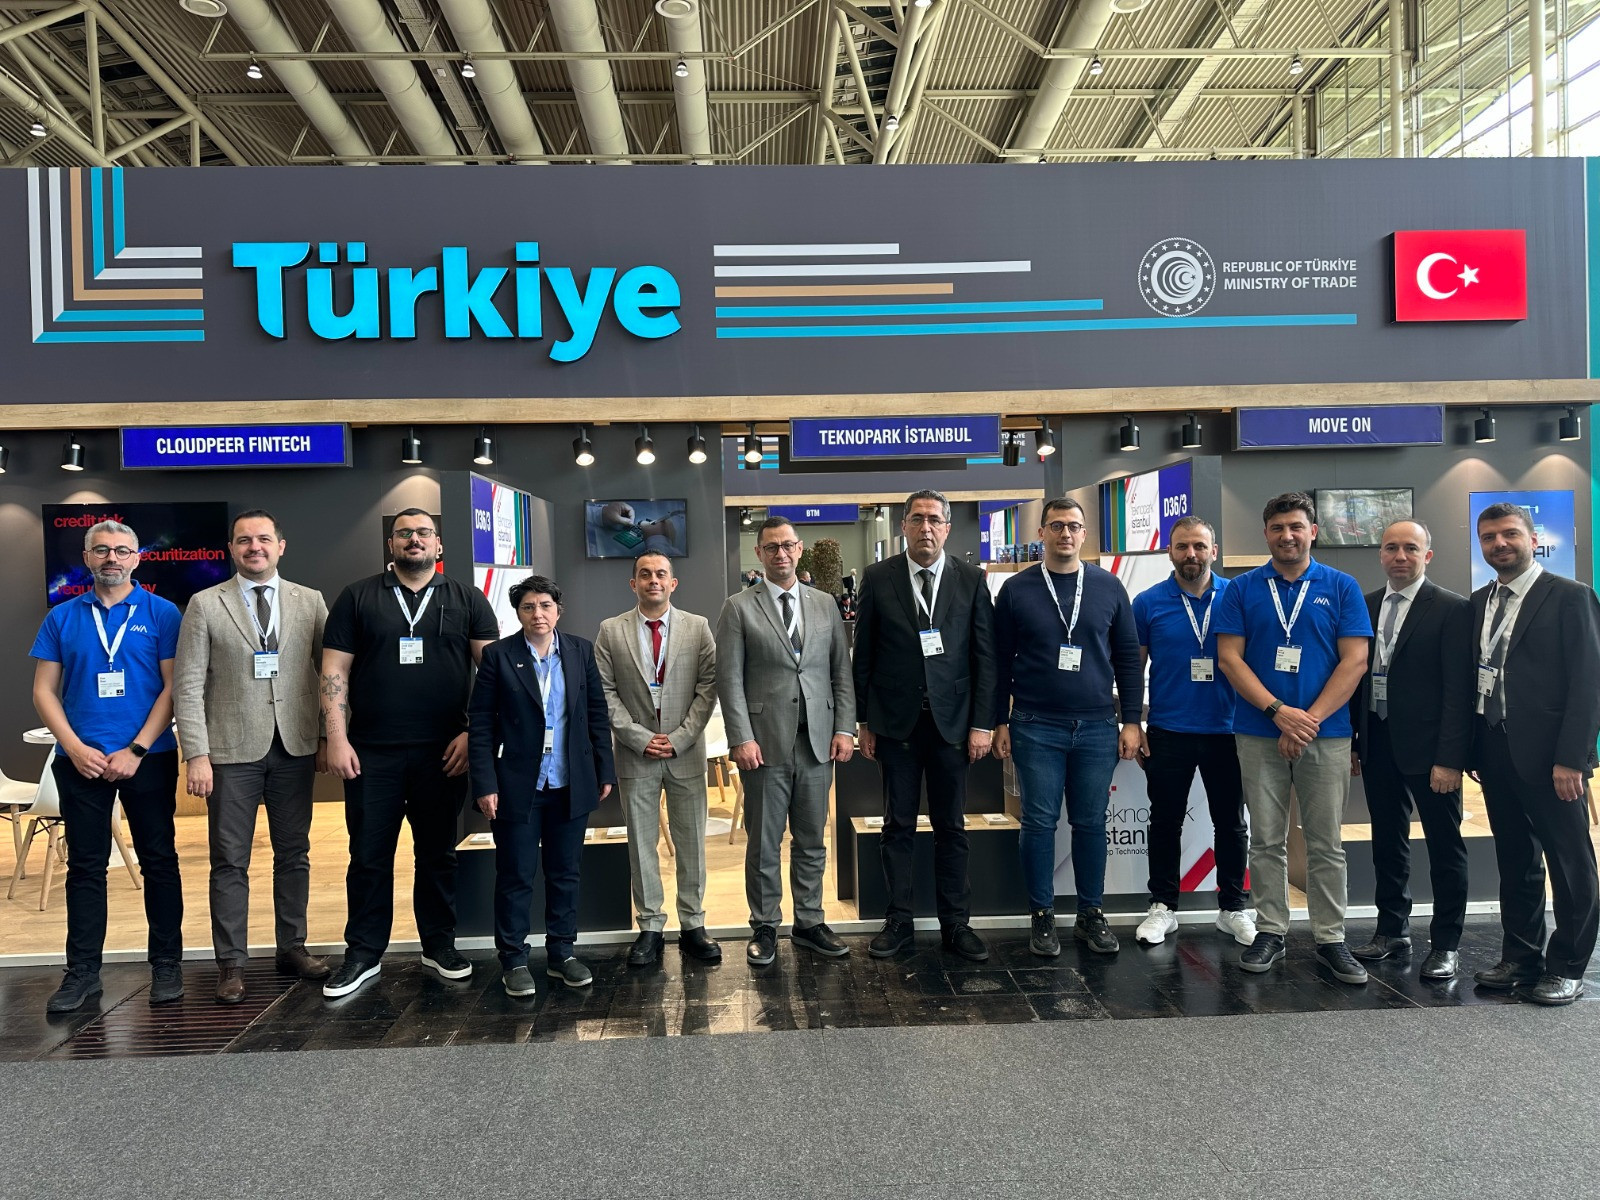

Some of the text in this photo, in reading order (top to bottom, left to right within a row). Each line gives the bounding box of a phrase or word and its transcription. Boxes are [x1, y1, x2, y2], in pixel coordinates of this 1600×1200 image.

[1222, 258, 1357, 273] REPUBLIC OF TÜRKİYE
[1224, 276, 1357, 290] MINISTRY OF TRADE
[232, 241, 682, 363] Türkiye
[1309, 417, 1371, 433] MOVE ON
[819, 425, 972, 445] TEKNOPARK İSTANBUL
[156, 436, 311, 454] CLOUDPEER FINTECH
[1163, 493, 1187, 517] D36/3
[806, 509, 820, 517] BTM
[54, 514, 96, 528] credit
[139, 547, 225, 562] ecuritization
[1115, 848, 1149, 856] Technolog
